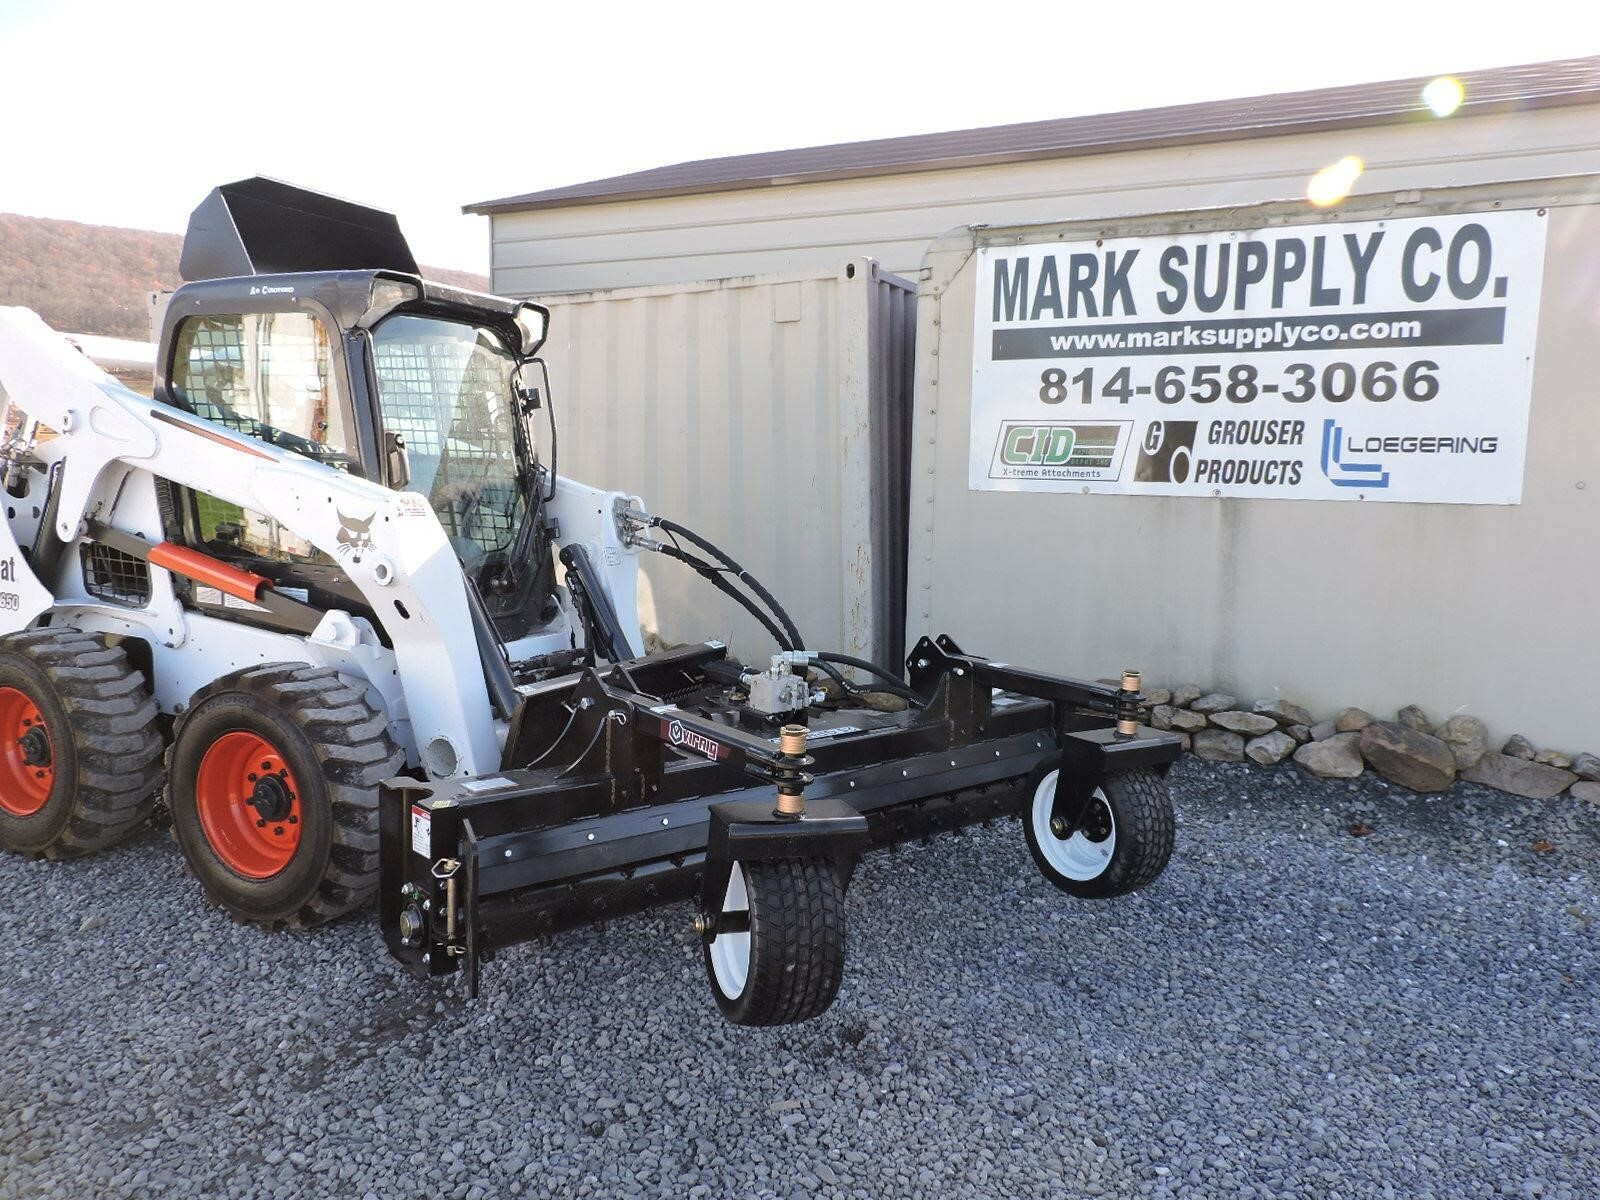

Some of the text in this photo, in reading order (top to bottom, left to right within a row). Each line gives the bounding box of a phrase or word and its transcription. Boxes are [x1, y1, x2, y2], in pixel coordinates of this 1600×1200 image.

[992, 223, 1508, 322] MARK SUPPLY CO.
[1050, 320, 1422, 350] www.marksupplyco.com
[1039, 360, 1440, 405] 814-658-3066
[1004, 427, 1076, 465] CID
[1207, 419, 1305, 445] GROUSER
[1347, 436, 1498, 454] LOEGERING
[1003, 468, 1101, 478] X-treme Attachments
[1194, 459, 1303, 485] PRODUCTS
